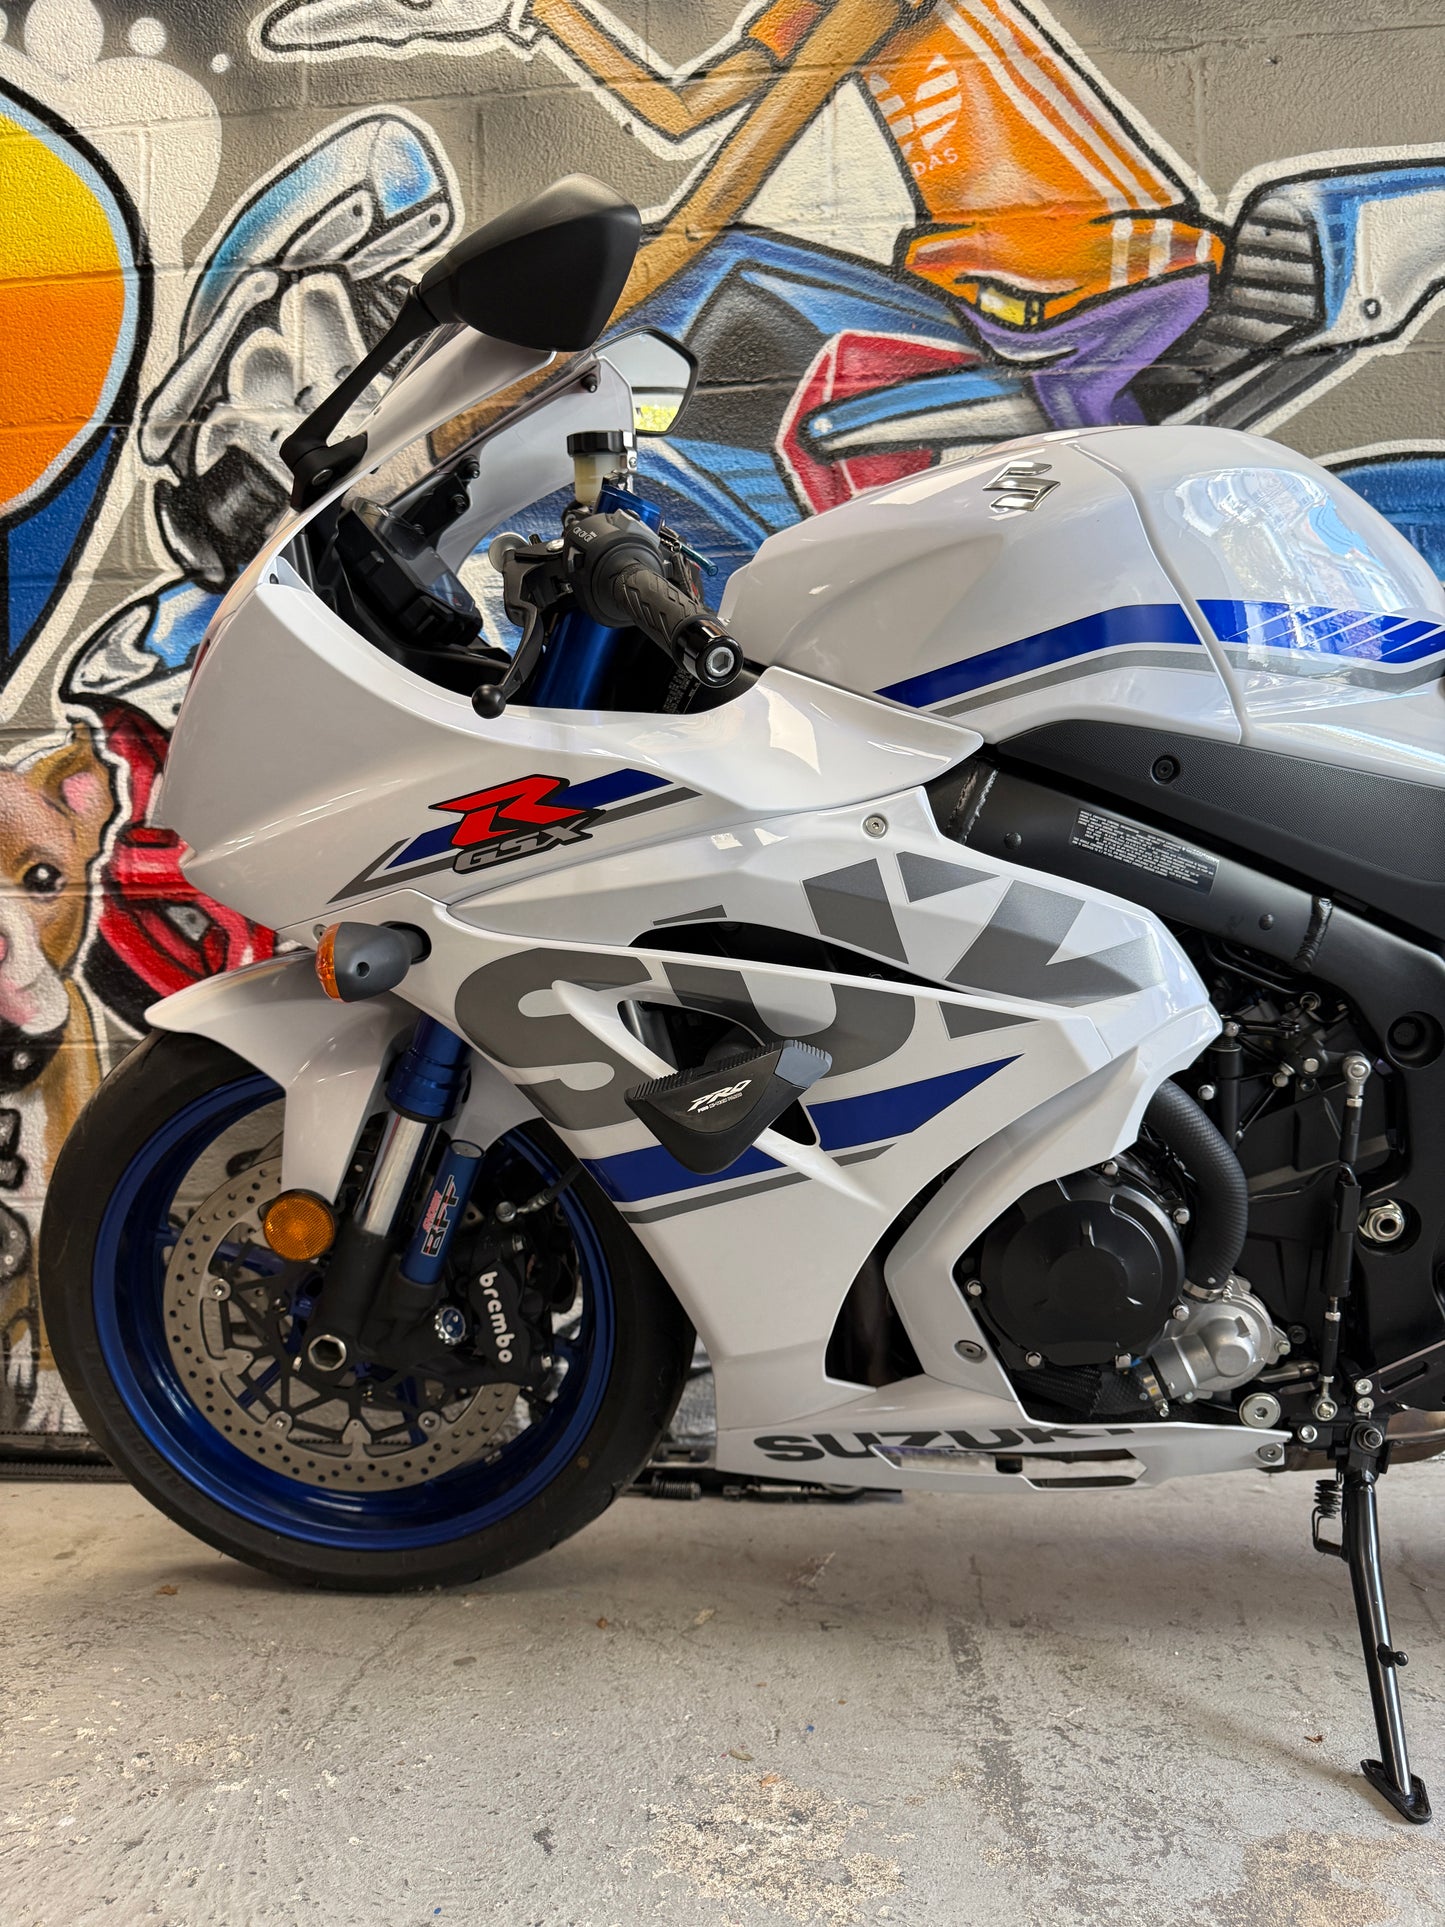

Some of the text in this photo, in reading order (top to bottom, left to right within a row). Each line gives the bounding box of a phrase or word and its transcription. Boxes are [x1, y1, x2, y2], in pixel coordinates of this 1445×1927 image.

[430, 774, 602, 848] R
[454, 820, 590, 873] GSX
[687, 1080, 752, 1112] PRO
[421, 1175, 459, 1257] BFF
[479, 1271, 515, 1363] brembo
[754, 1427, 1135, 1462] SUZUK
